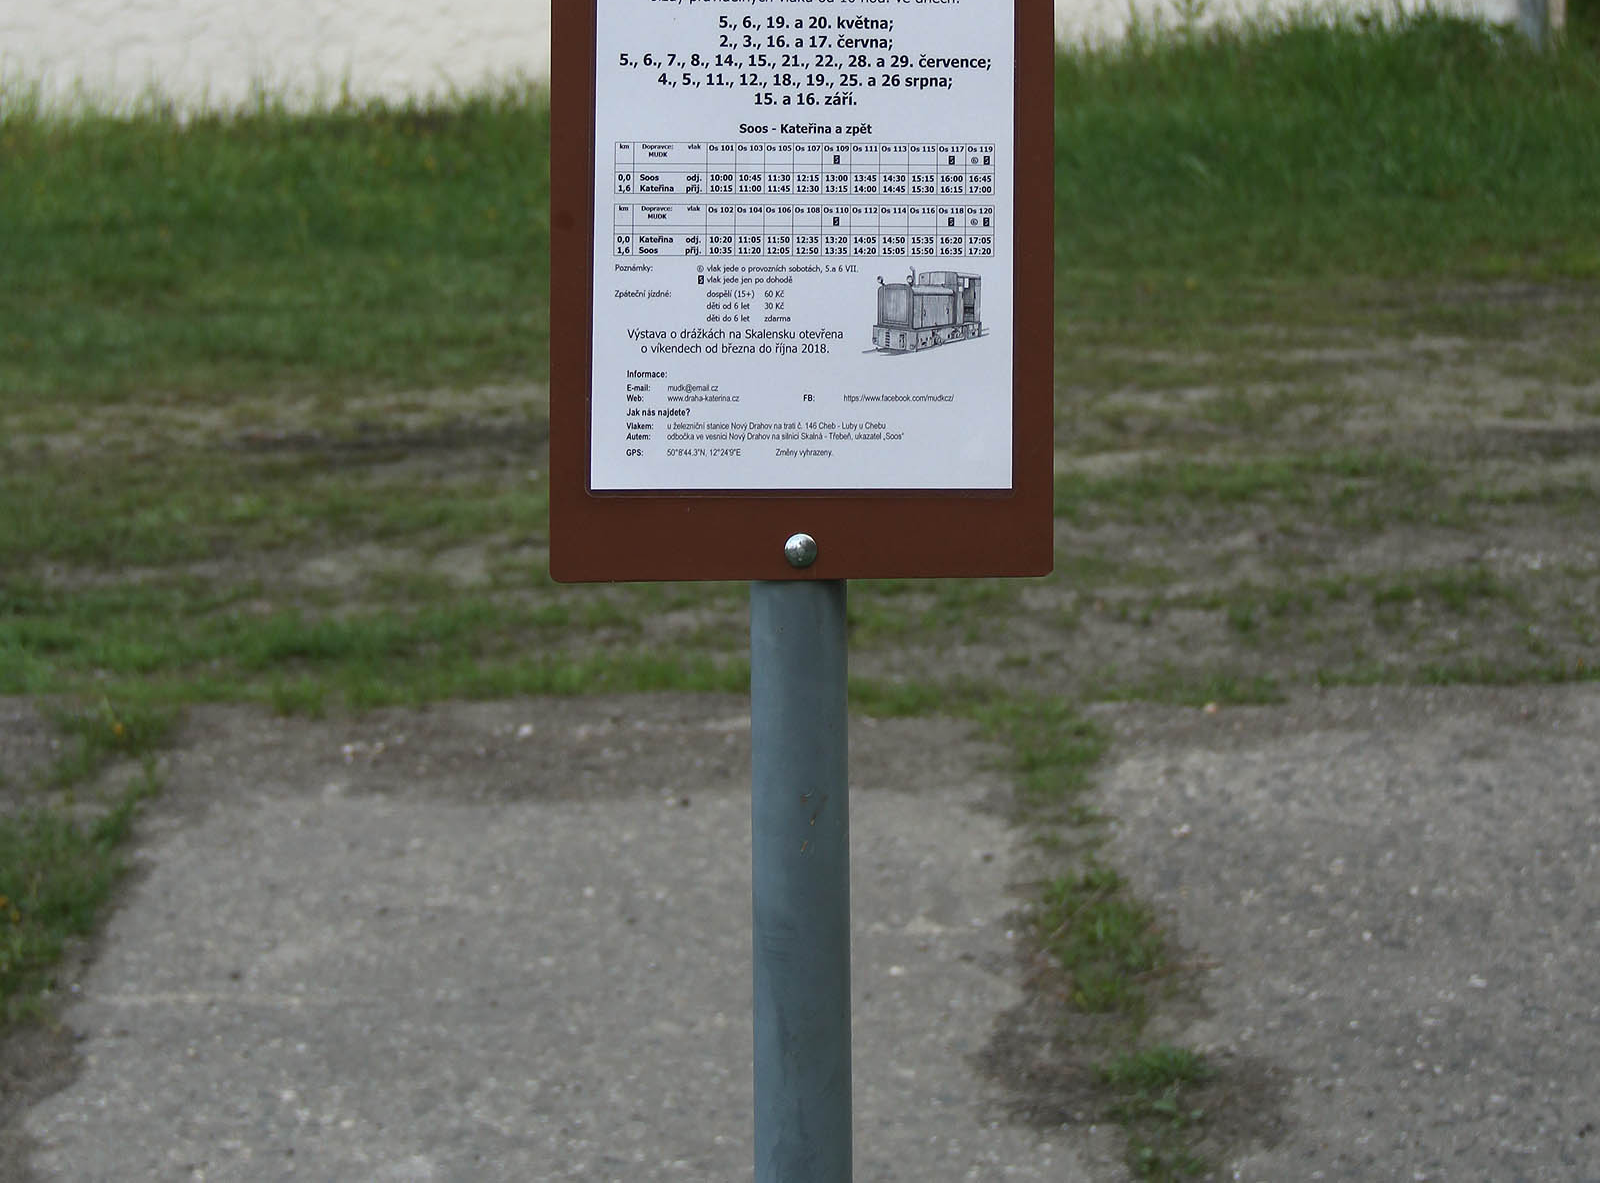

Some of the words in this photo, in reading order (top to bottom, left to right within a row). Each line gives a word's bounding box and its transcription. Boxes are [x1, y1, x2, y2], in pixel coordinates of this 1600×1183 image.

[719, 15, 737, 31] 5.,
[742, 15, 761, 31] 6.,
[767, 16, 789, 29] 19.
[794, 19, 803, 29] a
[808, 16, 831, 29] 20.
[837, 15, 893, 32] května;
[719, 34, 738, 50] 2.,
[743, 35, 761, 50] 3.,
[767, 35, 790, 48] 16.
[795, 38, 803, 48] a
[809, 35, 832, 48] 17.
[837, 34, 893, 51] června;
[619, 53, 638, 69] 5.,
[643, 53, 662, 69] 6.,
[667, 53, 686, 69] 7.,
[691, 53, 709, 69] 8.,
[715, 54, 743, 69] 14.,
[748, 54, 776, 70] 15.,
[781, 54, 810, 70] 21.,
[815, 54, 843, 70] 22.,
[848, 54, 871, 68] 28.
[876, 57, 885, 68] a
[890, 55, 913, 68] 29.
[918, 54, 991, 71] července;
[658, 73, 677, 88] 4.,
[682, 73, 701, 88] 5.,
[706, 73, 734, 89] 11.,
[740, 73, 767, 89] 12.,
[773, 73, 801, 89] 18.,
[806, 73, 834, 89] 19.,
[839, 74, 862, 87] 25.
[867, 77, 876, 87] a
[882, 74, 900, 87] 26
[905, 77, 952, 90] srpna;
[754, 92, 777, 105] 15.
[782, 95, 791, 105] a
[797, 92, 819, 106] 16.
[824, 91, 857, 106] září.
[739, 123, 768, 134] Soos
[780, 122, 832, 134] Kateřina
[835, 126, 842, 134] a
[845, 123, 872, 136] zpět
[642, 143, 674, 151] Dopravce:
[618, 174, 631, 183] 0,0
[686, 174, 702, 183] odj.
[710, 174, 733, 182] 10:00
[739, 174, 762, 182] 10:45
[768, 174, 791, 182] 11:30
[797, 174, 819, 182] 12:15
[825, 174, 848, 182] 13:00
[854, 174, 877, 182] 13:45
[912, 175, 934, 183] 15:15
[941, 175, 963, 183] 16:00
[969, 175, 992, 183] 16:45
[618, 184, 631, 193] 1,6
[640, 184, 674, 192] Kateřina
[686, 184, 702, 193] přij.
[710, 184, 733, 192] 10:15
[797, 185, 819, 193] 12:30
[825, 185, 848, 193] 13:15
[854, 185, 877, 193] 14:00
[883, 185, 906, 193] 14:45
[912, 185, 935, 193] 15:30
[617, 236, 630, 245] 0,0
[685, 236, 701, 245] odj.
[709, 236, 732, 244] 10:20
[738, 236, 761, 244] 11:05
[767, 236, 790, 244] 11:50
[796, 236, 819, 244] 12:35
[825, 236, 848, 244] 13:20
[854, 236, 876, 244] 14:05
[883, 236, 905, 244] 14:50
[911, 236, 934, 244] 15:35
[940, 236, 963, 244] 16:20
[969, 236, 991, 245] 17:05
[617, 246, 630, 255] 1,6
[639, 246, 658, 254] Soos
[685, 246, 702, 255] přij.
[709, 246, 732, 254] 10:35
[738, 246, 761, 254] 11:20
[796, 247, 819, 255] 12:50
[825, 247, 848, 255] 13:35
[854, 247, 877, 255] 14:20
[882, 247, 905, 255] 15:05
[911, 247, 934, 255] 15:50
[940, 247, 963, 255] 16:35
[969, 247, 991, 255] 17:20
[615, 263, 653, 273] Poznámky:
[614, 289, 646, 299] Zpáteční
[647, 289, 671, 299] jízdné:
[706, 289, 732, 299] dospělí
[734, 289, 755, 299] (15+)
[764, 290, 774, 298] 60
[775, 290, 784, 298] Kč
[627, 328, 667, 341] Výstava
[670, 331, 677, 339] o
[680, 328, 725, 339] drážkách
[729, 331, 741, 339] na
[745, 328, 795, 339] Skalensku
[799, 328, 843, 339] otevřena
[641, 345, 648, 354] o
[650, 342, 702, 354] víkendech
[705, 343, 718, 354] od
[721, 342, 755, 354] března
[759, 343, 772, 354] do
[775, 342, 798, 356] října
[801, 343, 829, 354] 2018.
[627, 370, 667, 378] Informace:
[626, 408, 640, 416] Jak
[642, 408, 656, 416] nás
[657, 408, 691, 418] najdete?
[626, 422, 654, 430] Vlakem:
[626, 432, 651, 440] Autem:
[626, 448, 644, 457] GPS:
